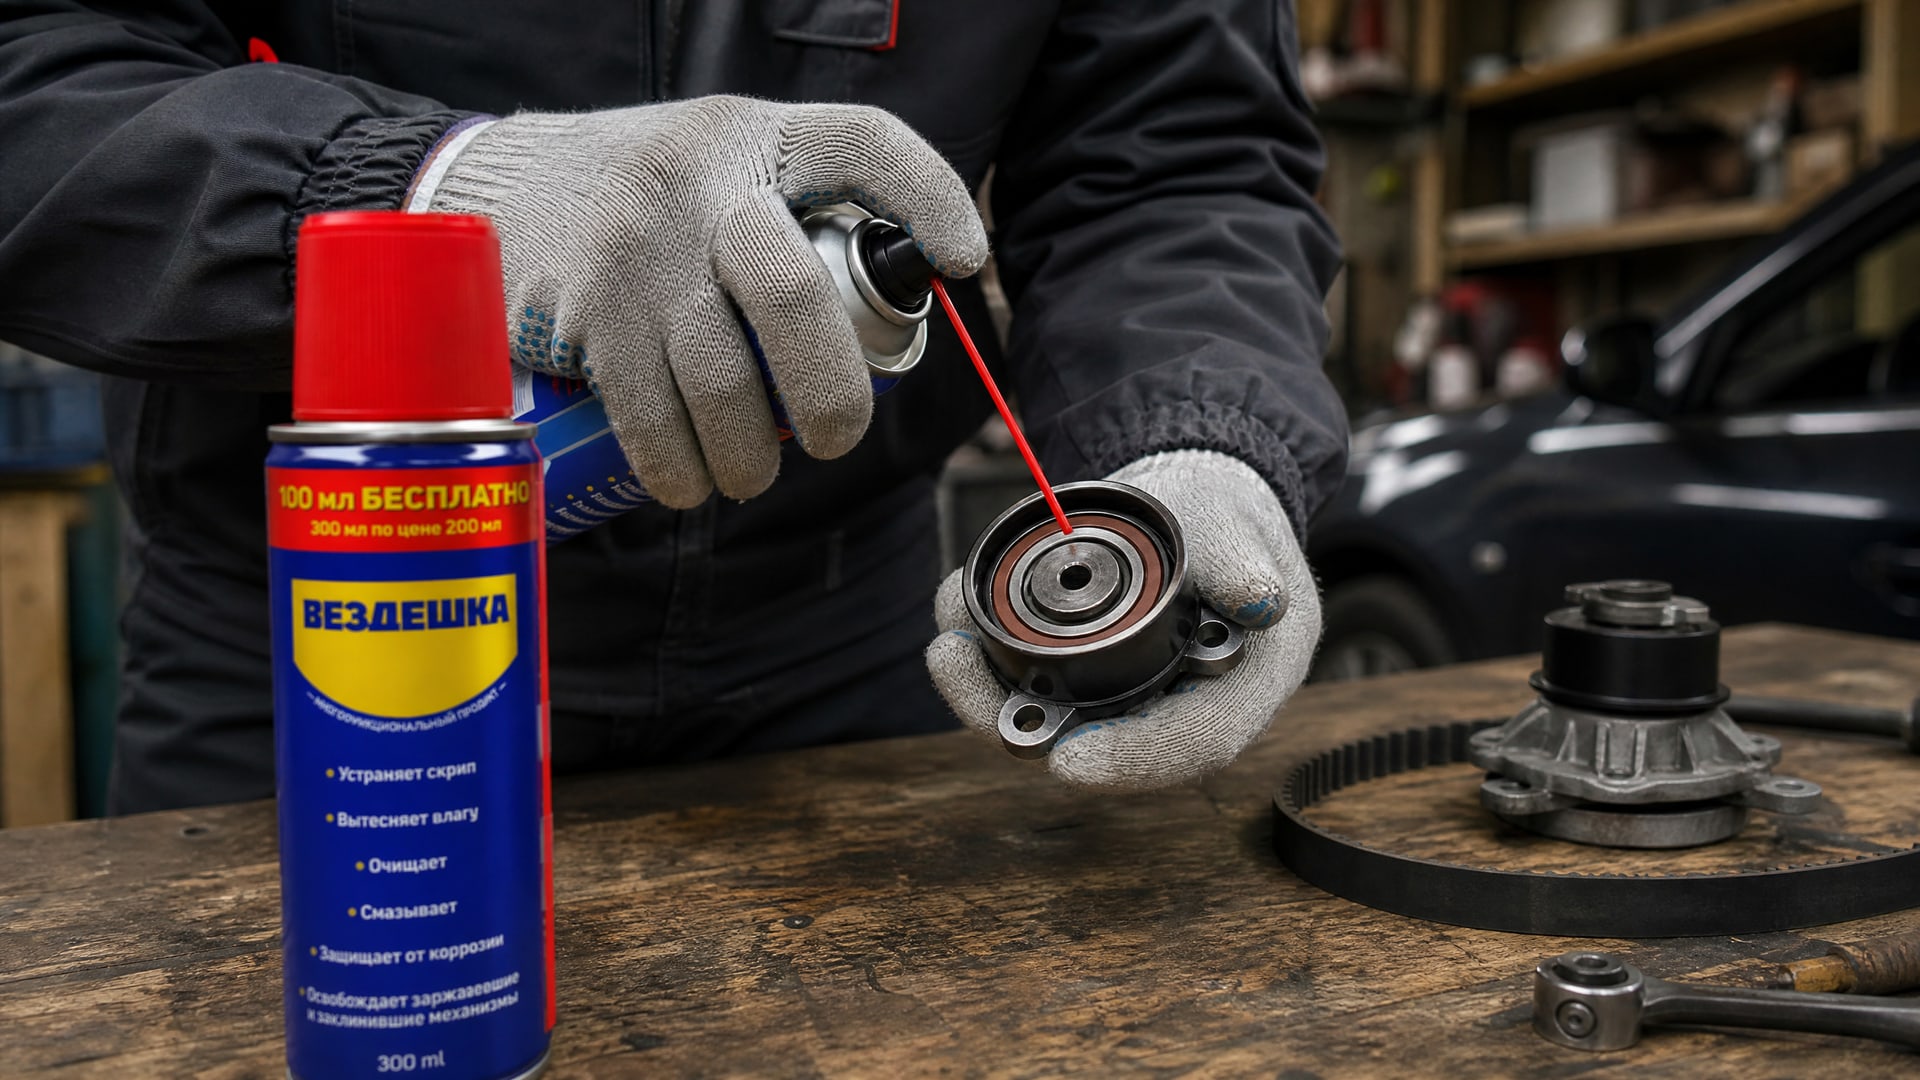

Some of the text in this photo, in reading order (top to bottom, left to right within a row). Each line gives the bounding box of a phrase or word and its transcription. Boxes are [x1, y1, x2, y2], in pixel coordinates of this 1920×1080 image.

[280, 481, 528, 510] 100 мл БЕСПЛАТНО
[311, 518, 501, 537] 300 мл по цене 200 мл
[304, 594, 509, 631] ВЕЗДЕШКА
[338, 762, 476, 785] Устраняет скрип
[337, 807, 478, 828] Вытесняет влагу
[369, 857, 447, 873] Очищает
[361, 901, 457, 920] Смазывает
[320, 934, 504, 966] Защищает от коррозии
[307, 986, 409, 1011] Освобождает
[317, 1011, 425, 1028] заклинившие
[428, 991, 519, 1023] механизмы
[378, 1050, 445, 1072] 300 ml
